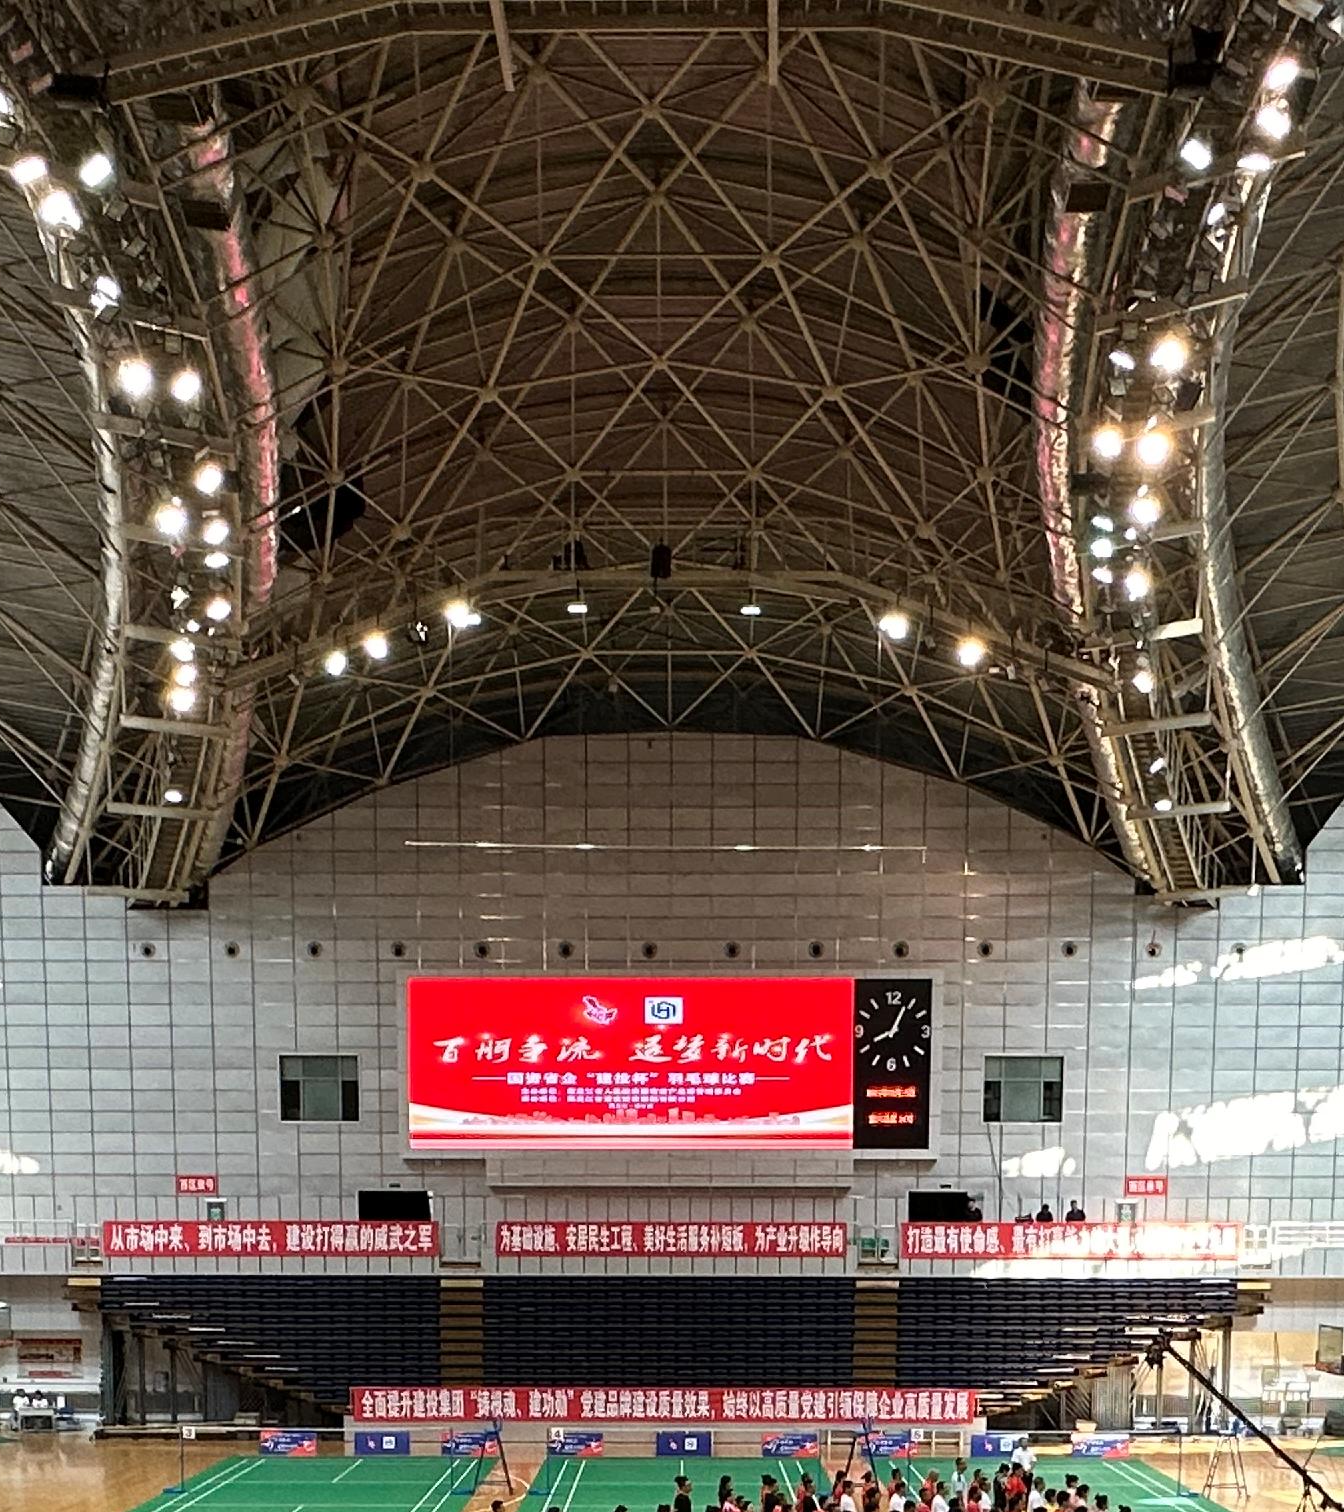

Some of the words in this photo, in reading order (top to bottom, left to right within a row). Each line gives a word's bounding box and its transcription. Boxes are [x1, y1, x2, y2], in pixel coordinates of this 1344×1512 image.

[885, 990, 902, 1005] 12
[855, 1024, 864, 1038] 9
[921, 1024, 931, 1038] 3
[886, 1057, 897, 1071] 6
